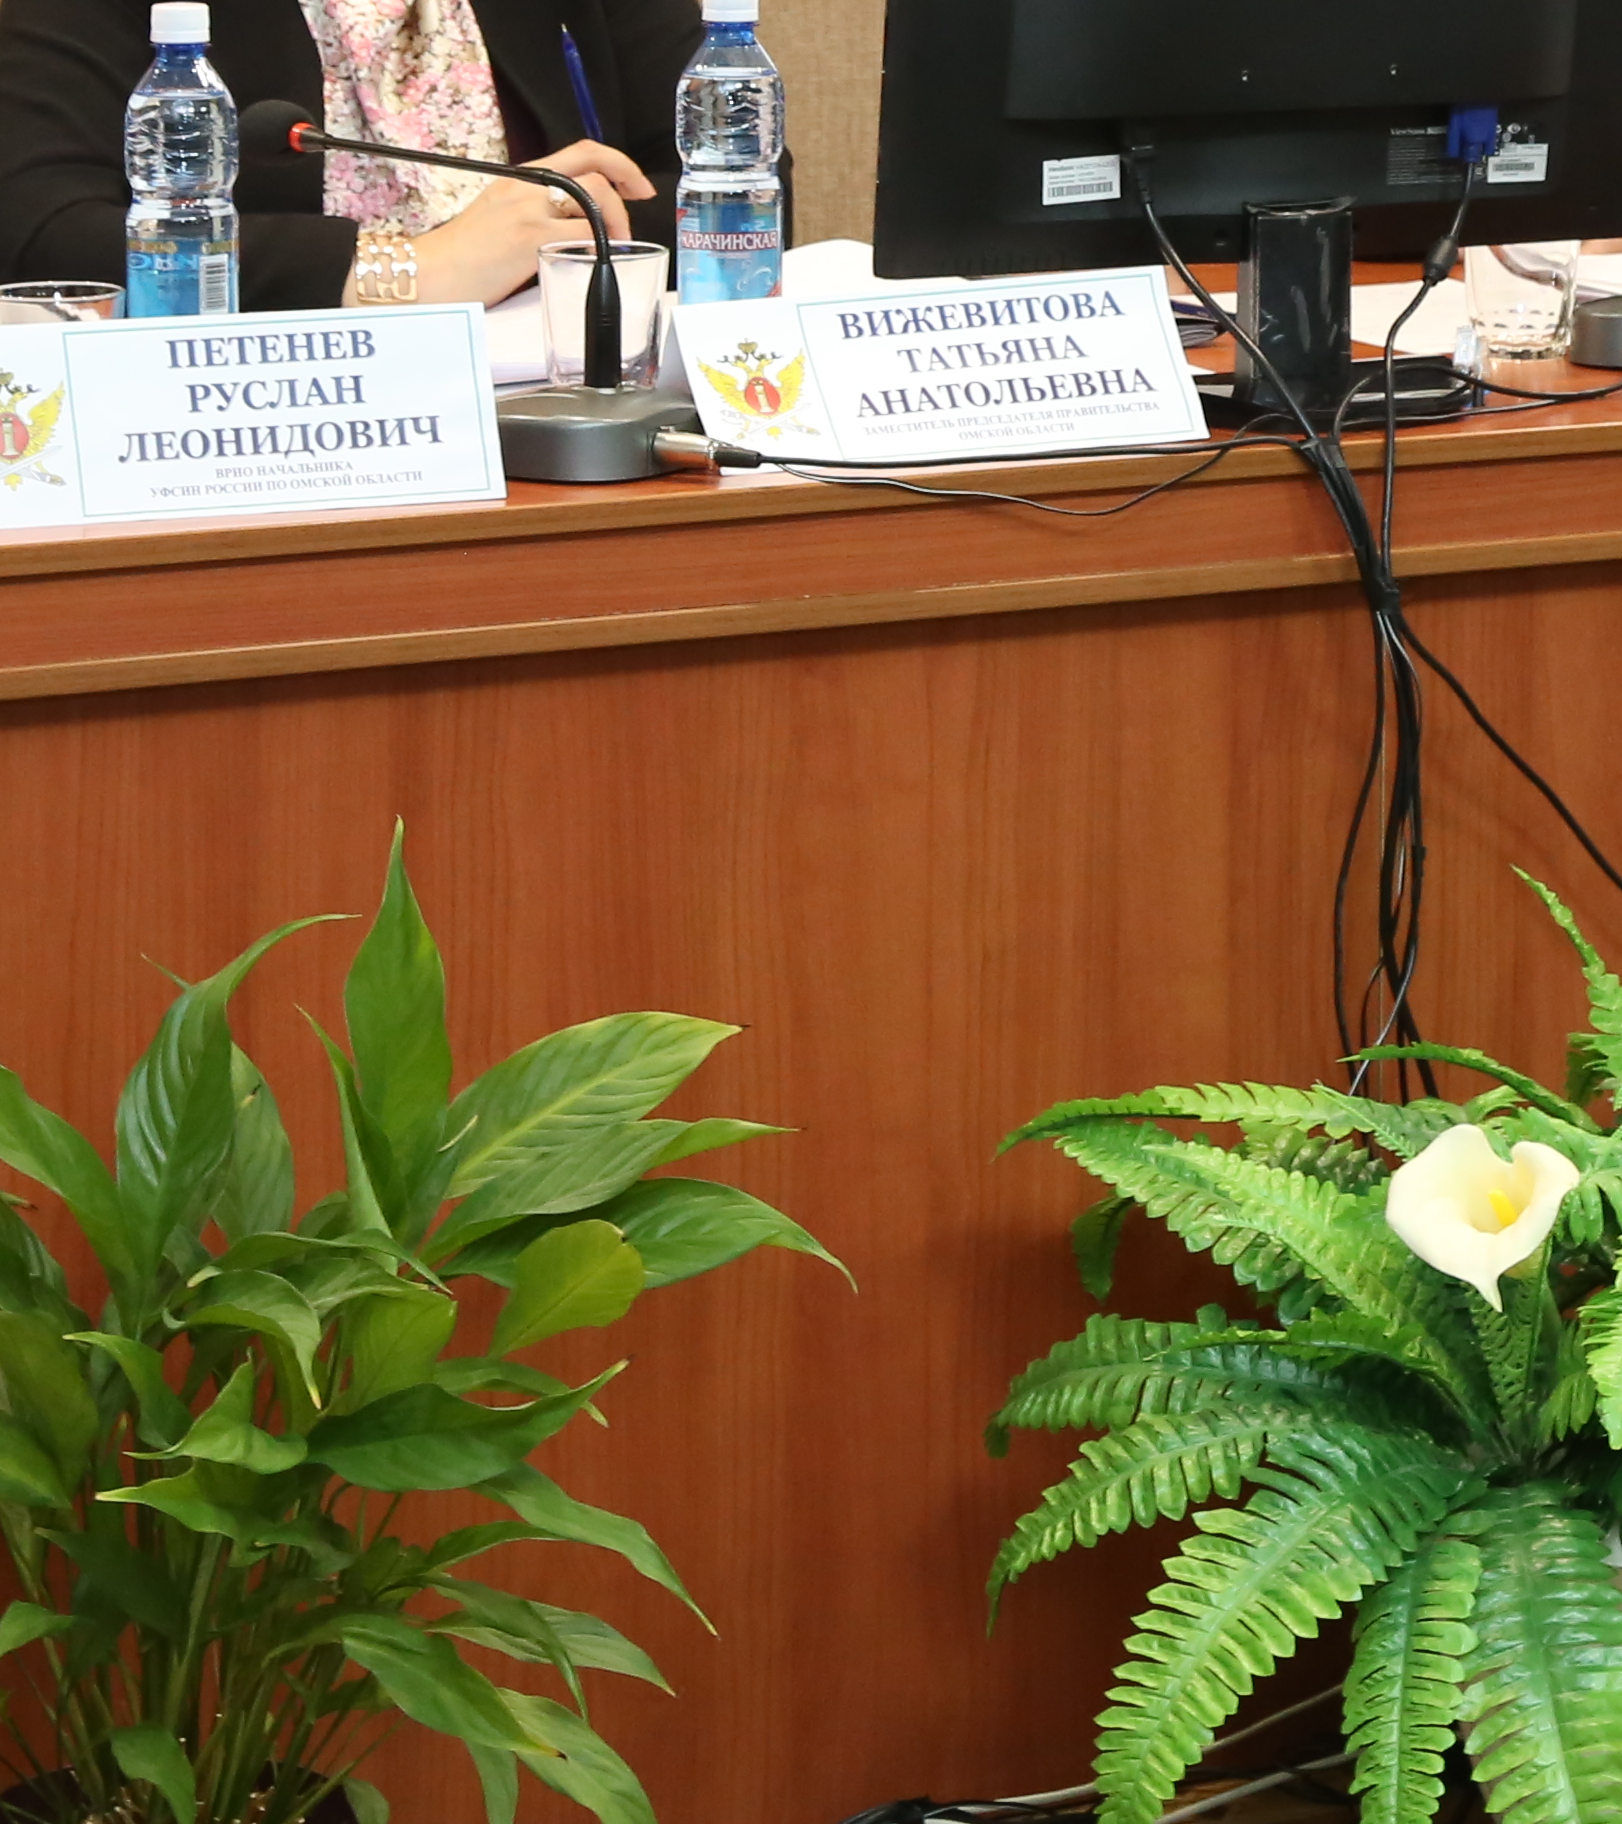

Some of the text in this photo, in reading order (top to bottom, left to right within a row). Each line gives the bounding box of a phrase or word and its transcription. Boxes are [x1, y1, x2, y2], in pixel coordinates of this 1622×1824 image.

[836, 290, 1126, 339] ВИЖЕВИТОВА
[165, 329, 376, 369] ПЕТЕНЕВ
[897, 334, 1090, 373] ТАТЬЯНА
[185, 374, 366, 413] РУСЛАН
[856, 367, 1157, 418] АНАТОЛЬЕВНА
[862, 401, 1161, 436] ЗАМЕСТИТЕЛЬ ПРЕДСЕДАТЕЛЯ ПРАВИТЕЛЬСТВА
[958, 422, 1075, 441] ОМСКОЙ ОБЛАСТИ
[118, 415, 443, 464] ЛЕОНИДОВИЧ
[149, 470, 422, 499] УФСИН РОССИИ ПО ОМСКОЙ ОБЛАСТИ
[215, 461, 353, 479] ВРИО НАЧАЛЬНИКА
